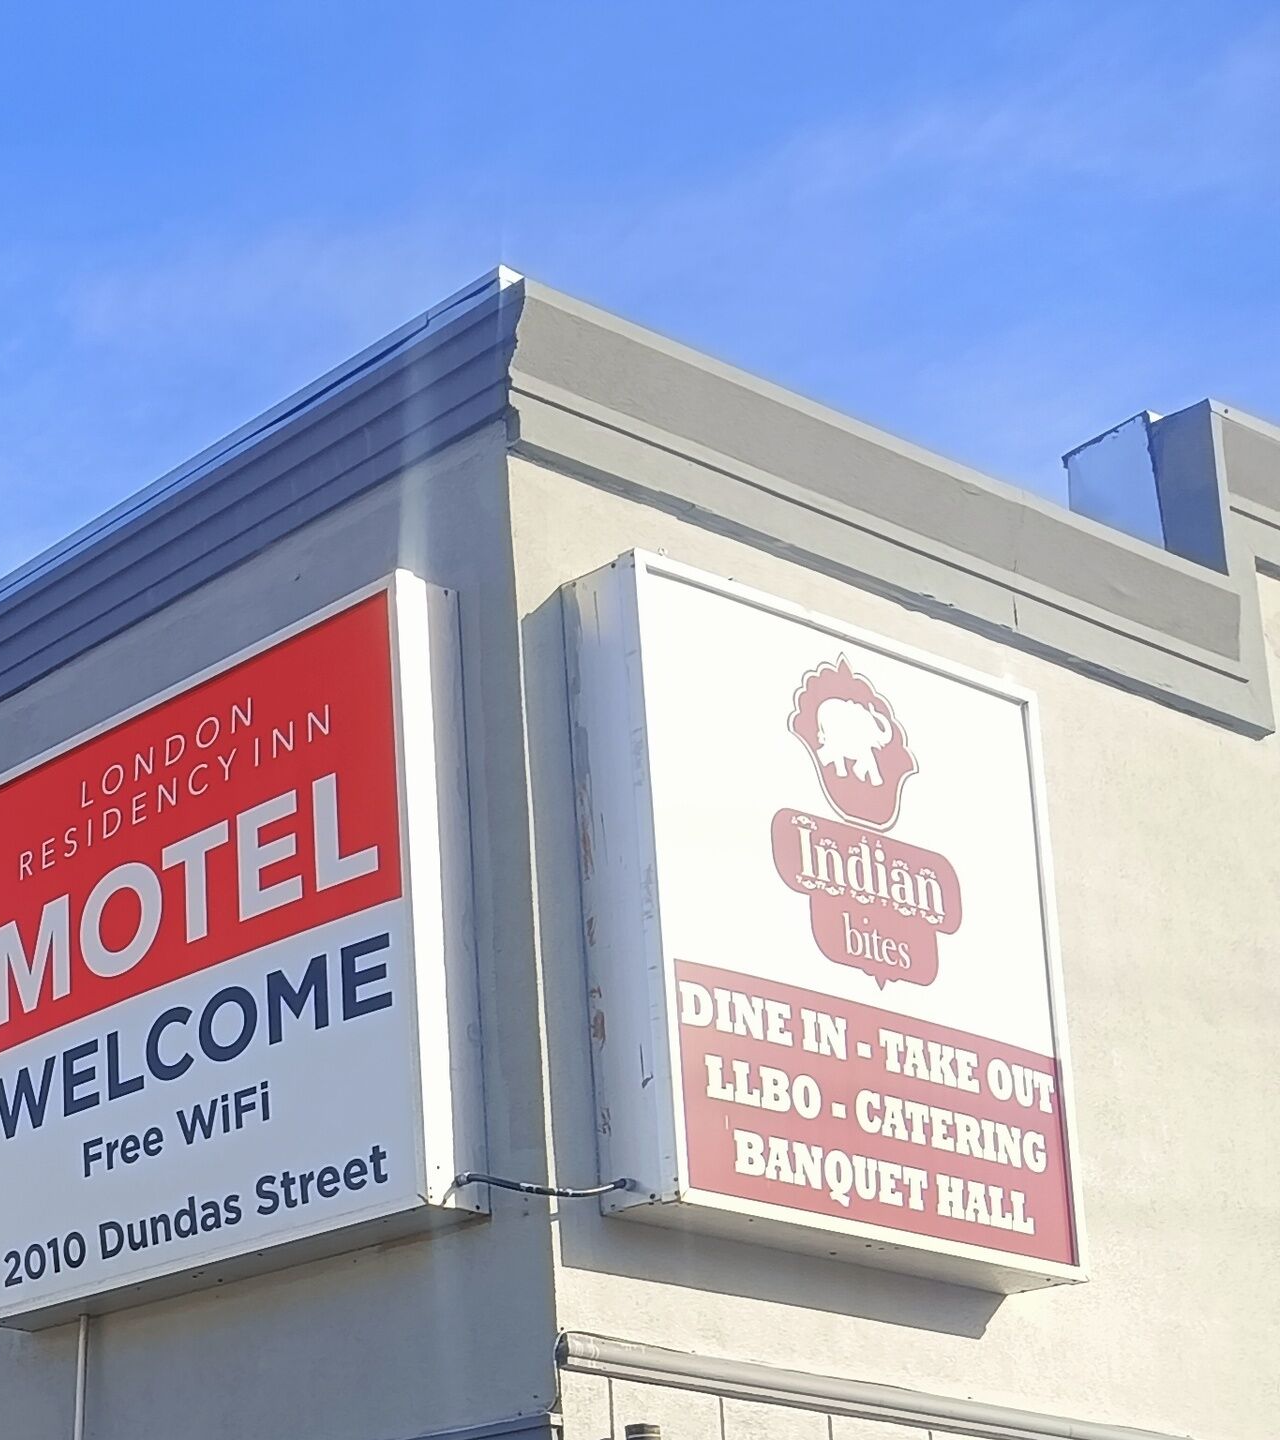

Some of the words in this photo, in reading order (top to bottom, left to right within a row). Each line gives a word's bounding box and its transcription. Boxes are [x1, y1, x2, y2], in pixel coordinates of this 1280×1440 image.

[18, 748, 238, 881] RESIDENCY
[253, 704, 331, 767] INN
[80, 696, 253, 808] LONDON
[791, 815, 946, 923] Indian
[842, 911, 911, 969] bites
[678, 980, 793, 1047] DINE
[801, 1008, 847, 1060] IN
[879, 1028, 980, 1094] TAKE
[986, 1058, 1055, 1114] OUT
[83, 1126, 163, 1177] Free
[176, 1080, 271, 1145] WiFi
[704, 1054, 821, 1119] LLBO
[855, 1088, 1047, 1173] CATERING
[4, 1232, 86, 1287] 2010
[98, 1196, 242, 1260] Dundas
[255, 1145, 388, 1216] Street
[734, 1128, 928, 1208] BANQUET
[935, 1172, 1035, 1235] HALL
